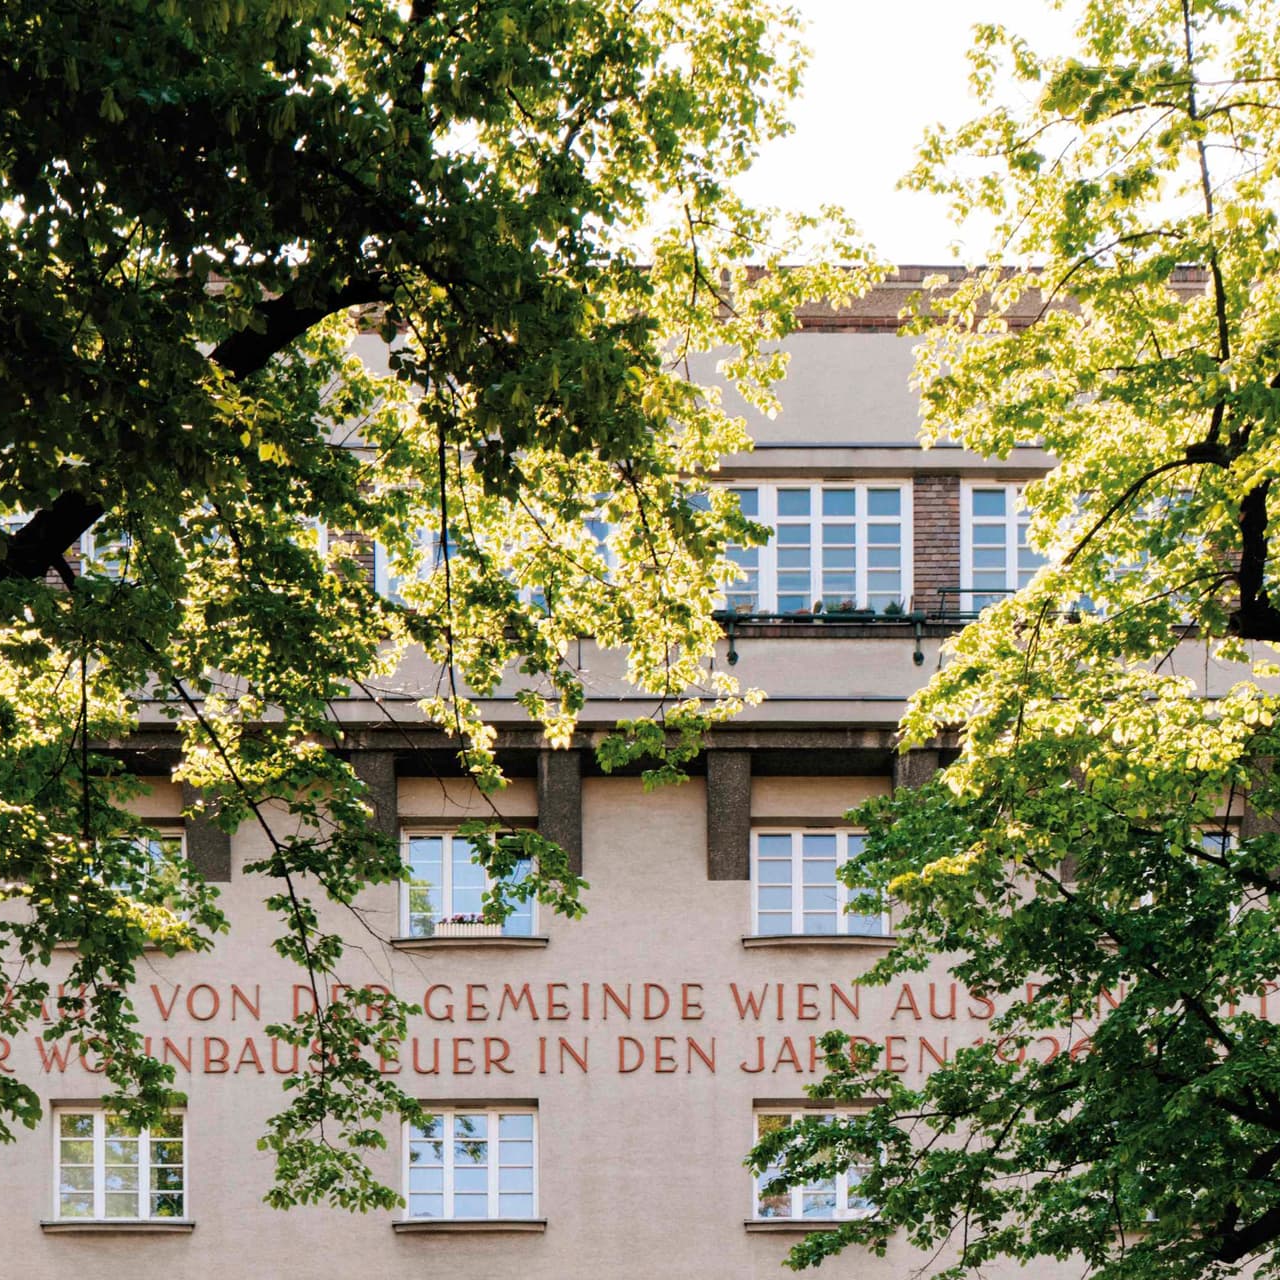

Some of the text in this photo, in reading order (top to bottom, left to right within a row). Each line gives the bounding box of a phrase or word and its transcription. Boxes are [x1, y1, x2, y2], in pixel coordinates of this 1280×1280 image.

[150, 983, 261, 1021] VON
[292, 983, 395, 1021] DER
[423, 983, 704, 1022] GEMEINDE
[730, 982, 860, 1020] WIEN
[890, 982, 996, 1020] AUS
[34, 1036, 516, 1074] WONBAUSEUER
[538, 1036, 589, 1074] IN
[618, 1035, 717, 1073] DEN
